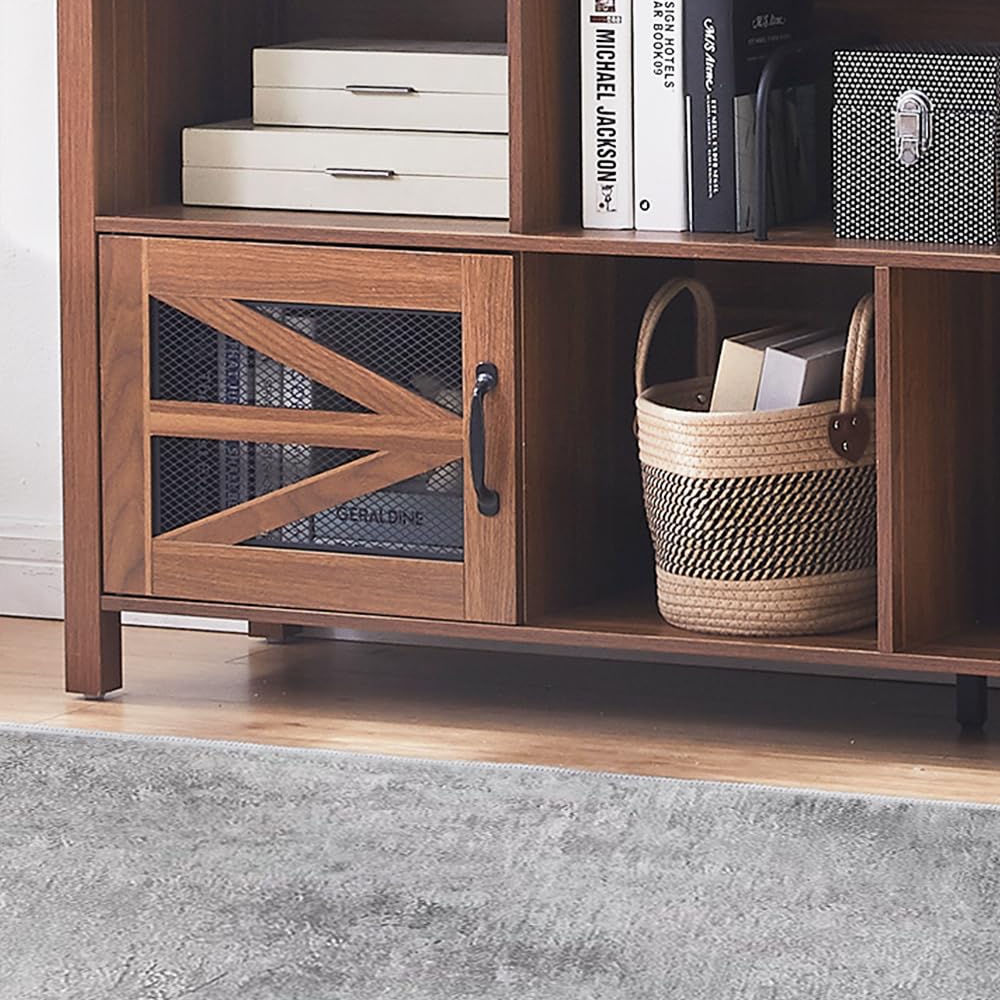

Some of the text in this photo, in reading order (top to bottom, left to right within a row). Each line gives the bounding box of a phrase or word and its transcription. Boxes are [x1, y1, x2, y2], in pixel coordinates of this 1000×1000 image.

[596, 29, 616, 101] MICHAEL
[664, 36, 675, 88] HOTELS
[596, 105, 616, 183] JACKSON
[336, 506, 425, 526] GERALDINE
